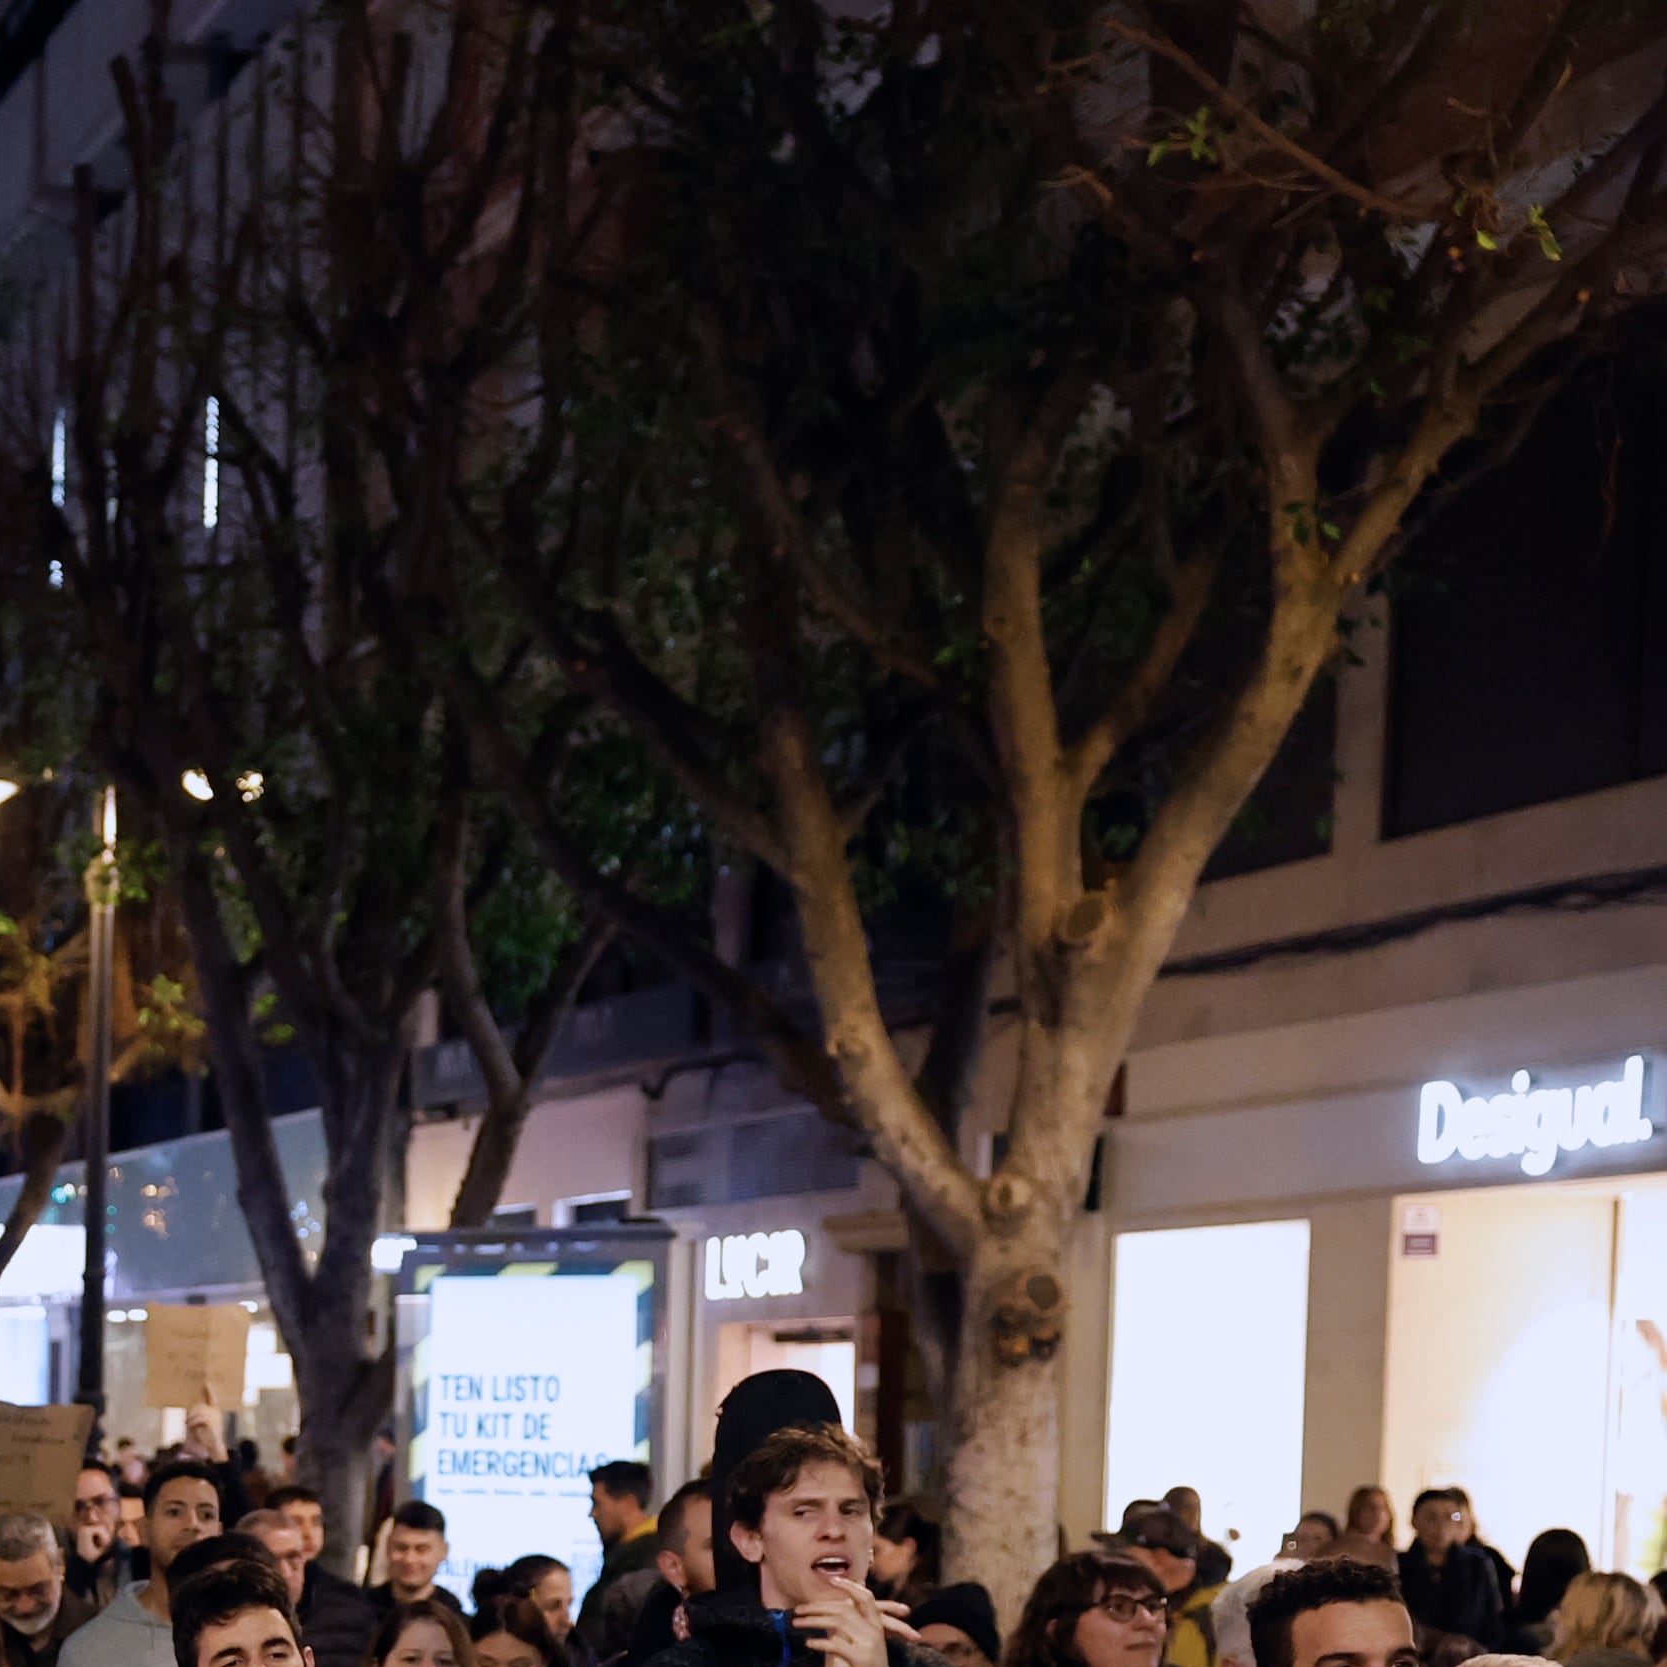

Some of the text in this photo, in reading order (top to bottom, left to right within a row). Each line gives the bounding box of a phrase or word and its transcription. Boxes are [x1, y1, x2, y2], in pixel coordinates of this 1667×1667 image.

[440, 1375, 561, 1402] TEN LISTO
[440, 1412, 550, 1440] TU KIT DE
